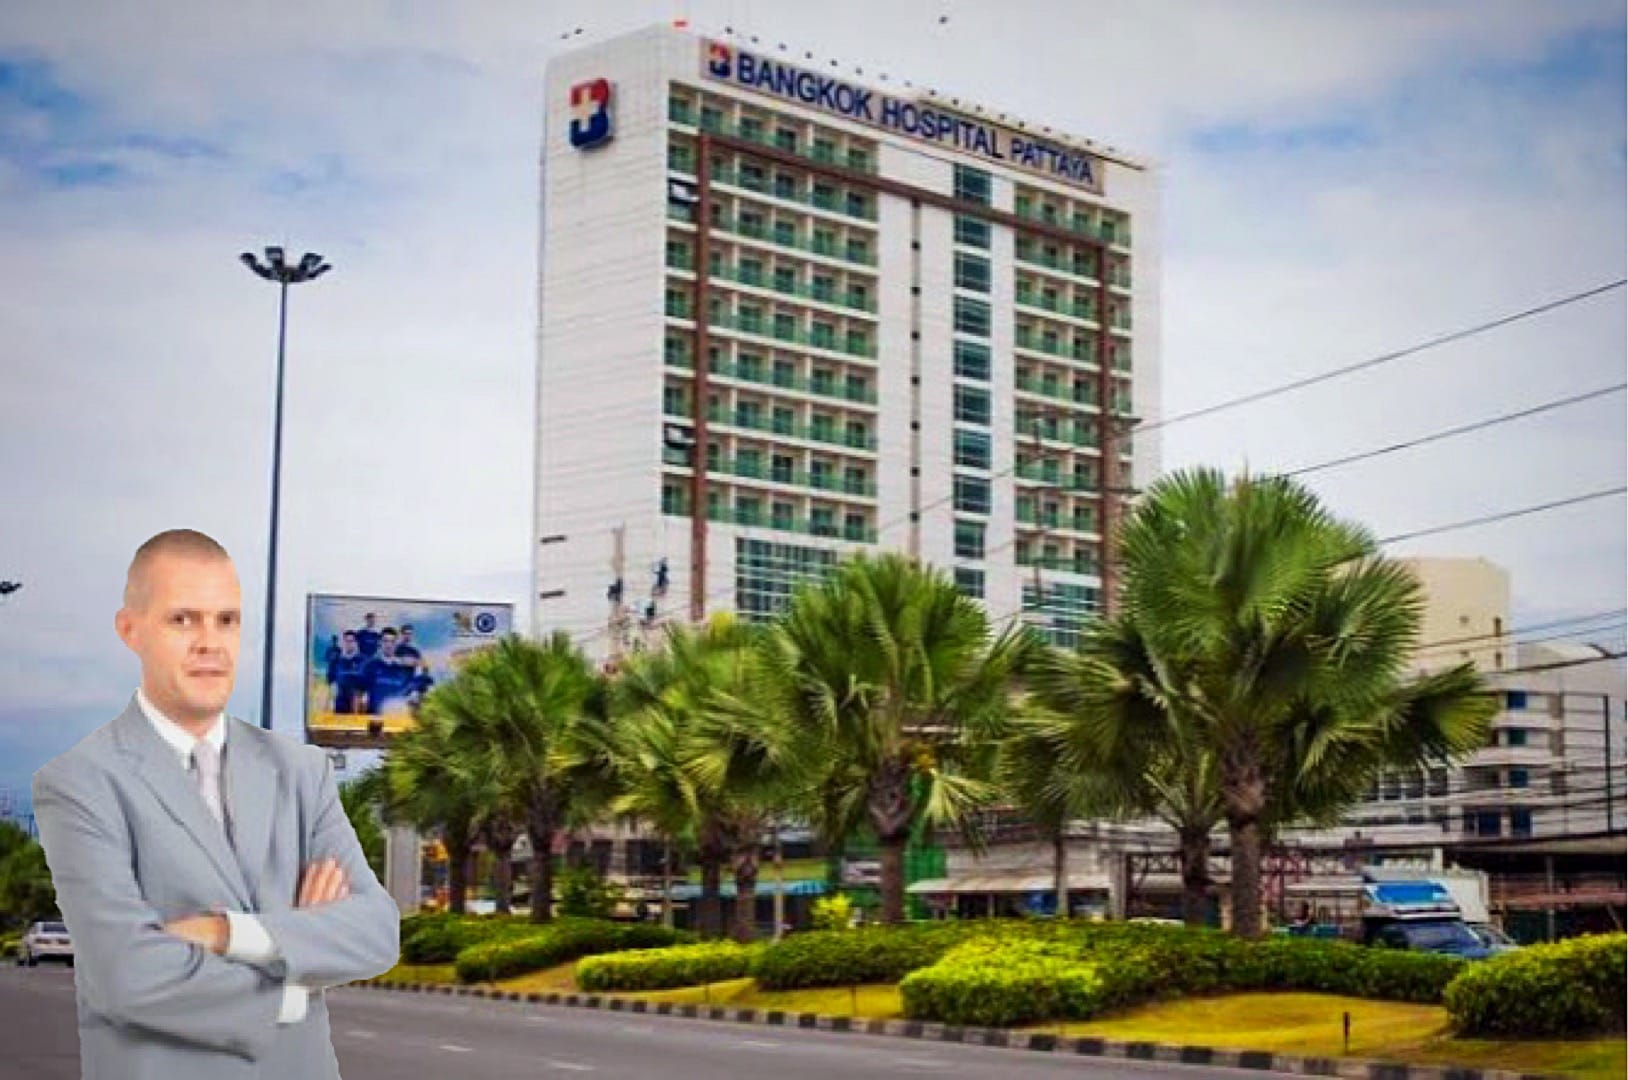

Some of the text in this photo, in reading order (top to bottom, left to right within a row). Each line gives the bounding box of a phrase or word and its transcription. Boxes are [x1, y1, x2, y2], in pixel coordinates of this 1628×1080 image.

[737, 52, 874, 121] BANGKOK
[881, 95, 1004, 159] HOSPITAL
[1010, 137, 1094, 184] PATTAYA
